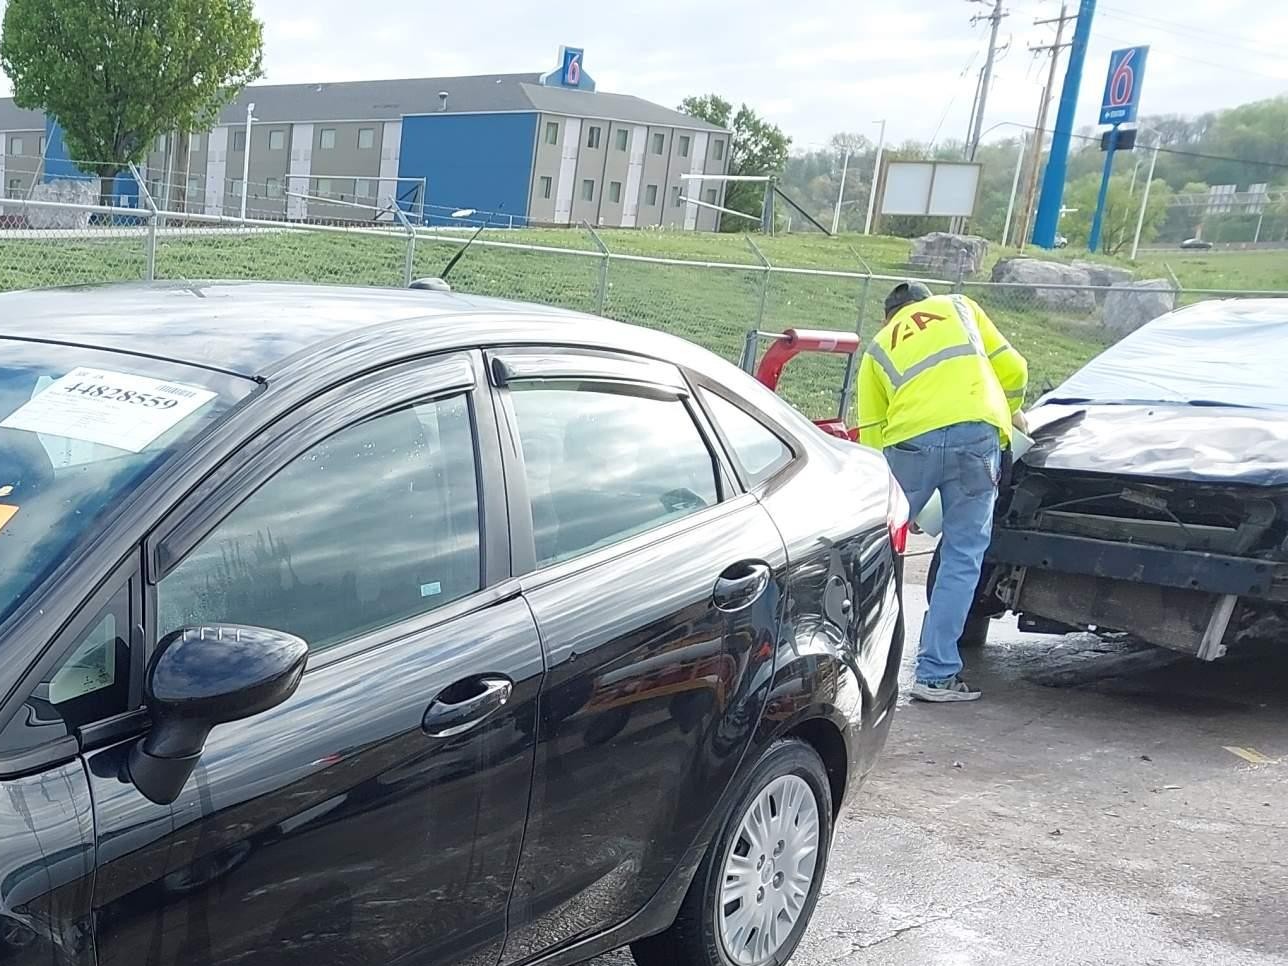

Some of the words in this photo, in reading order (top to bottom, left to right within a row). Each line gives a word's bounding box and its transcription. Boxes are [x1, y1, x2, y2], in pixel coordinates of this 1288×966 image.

[567, 54, 580, 85] 6
[1110, 49, 1135, 106] 6
[64, 381, 179, 410] 44828559
